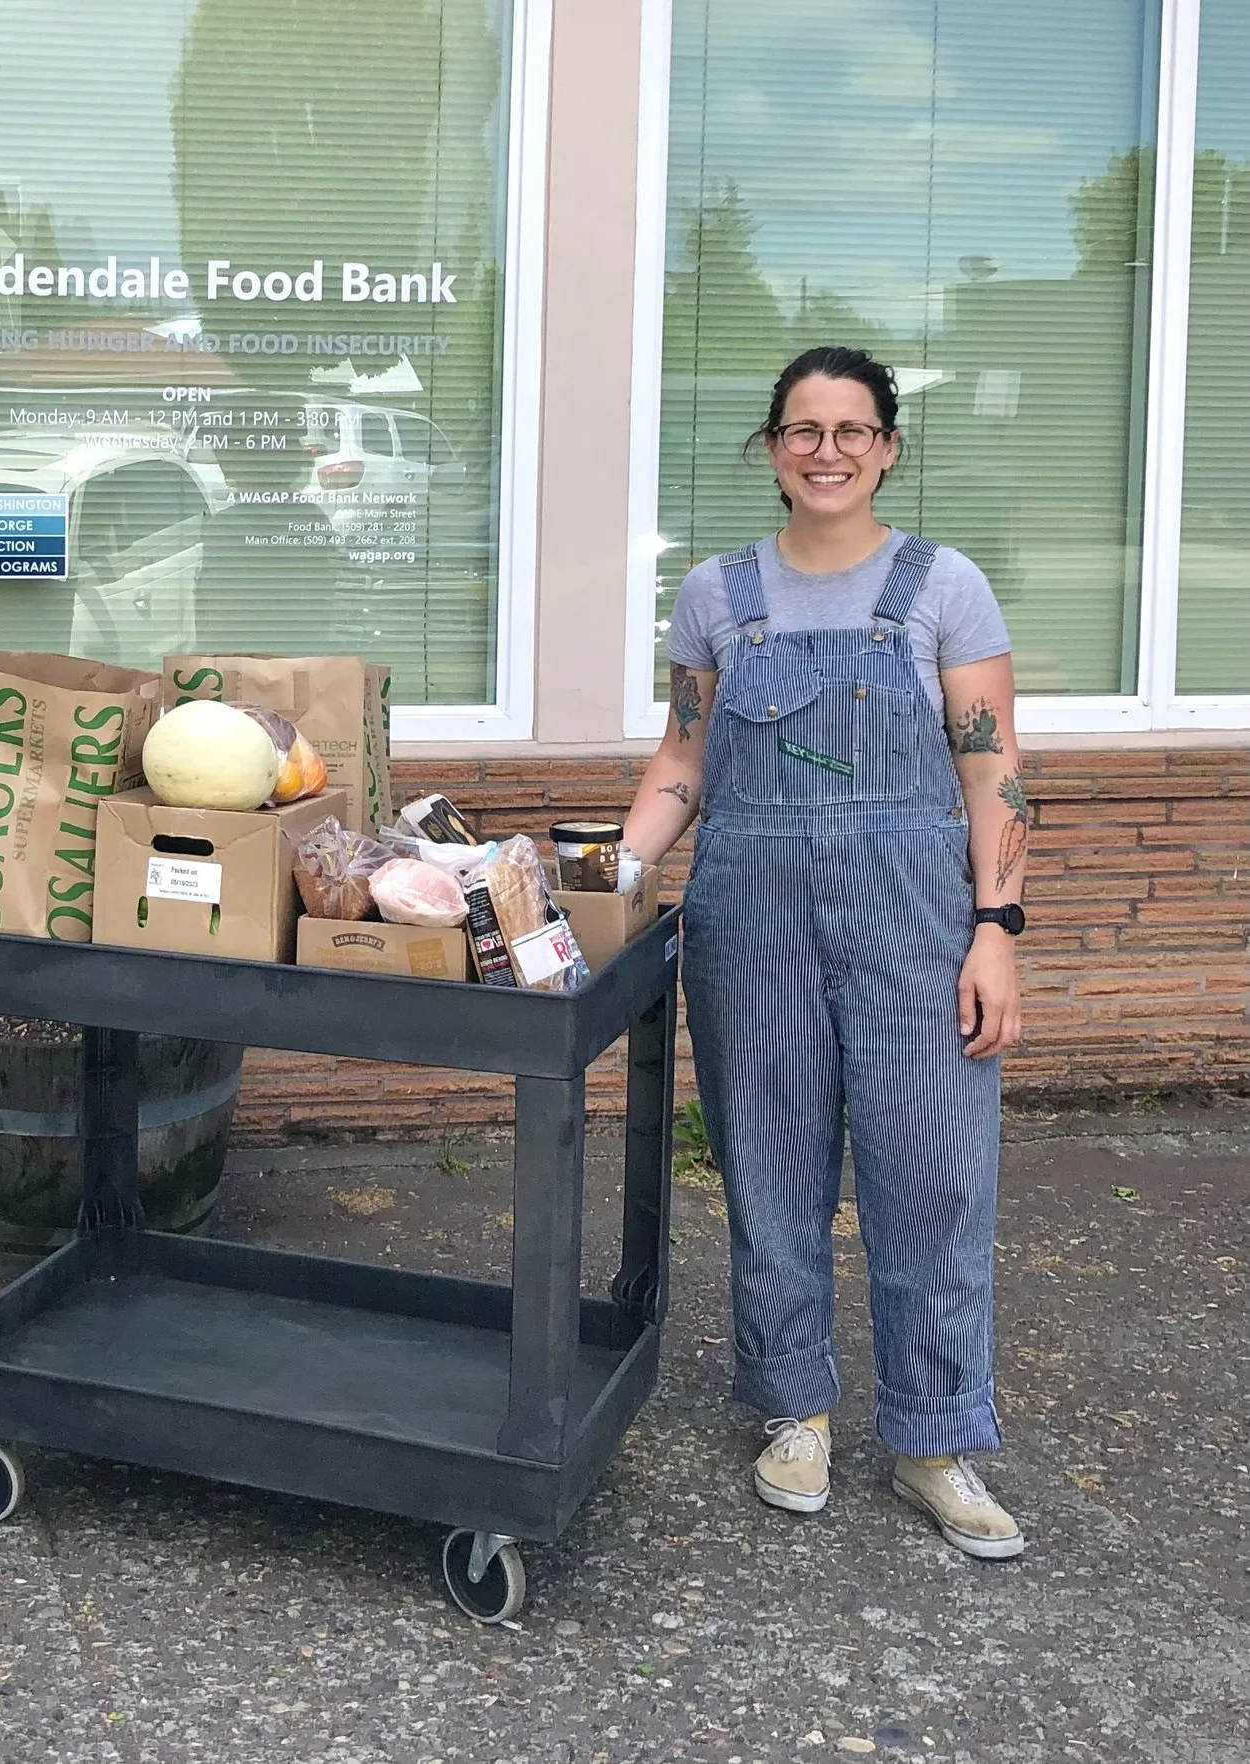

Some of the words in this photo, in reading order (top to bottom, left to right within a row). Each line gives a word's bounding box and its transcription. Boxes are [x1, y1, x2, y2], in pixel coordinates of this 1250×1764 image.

[207, 259, 323, 301] Food
[342, 262, 458, 303] Bank
[48, 329, 155, 353] HUNGER
[164, 332, 220, 354] AND
[229, 333, 299, 355] FOOD
[307, 334, 450, 356] INSECURITY
[162, 387, 211, 402] OPEN
[10, 408, 81, 428] Monday:
[86, 409, 96, 424] 9
[101, 410, 129, 424] AM
[149, 410, 166, 425] 12
[172, 411, 197, 425] PM
[203, 410, 233, 426] and
[239, 411, 246, 426] 1
[253, 411, 278, 426] PM
[203, 435, 228, 449] PM
[246, 434, 255, 449] 6
[261, 435, 286, 449] PM
[226, 492, 236, 503] A
[239, 492, 289, 503] WAGAP
[293, 492, 323, 503] Food
[329, 492, 358, 504] Bank
[363, 493, 417, 504] Network
[365, 508, 388, 518] Main
[390, 508, 416, 518] Street
[288, 522, 311, 532] Food
[367, 523, 384, 532] 281
[393, 523, 416, 532] 2203
[245, 536, 268, 545] Main
[271, 535, 301, 545] Office:
[303, 536, 326, 546] (509)
[329, 536, 346, 545] 493
[355, 536, 378, 545] 2662
[399, 536, 416, 545] 208
[349, 551, 415, 563] wagap.org
[12, 698, 47, 862] SUPERMARKETS
